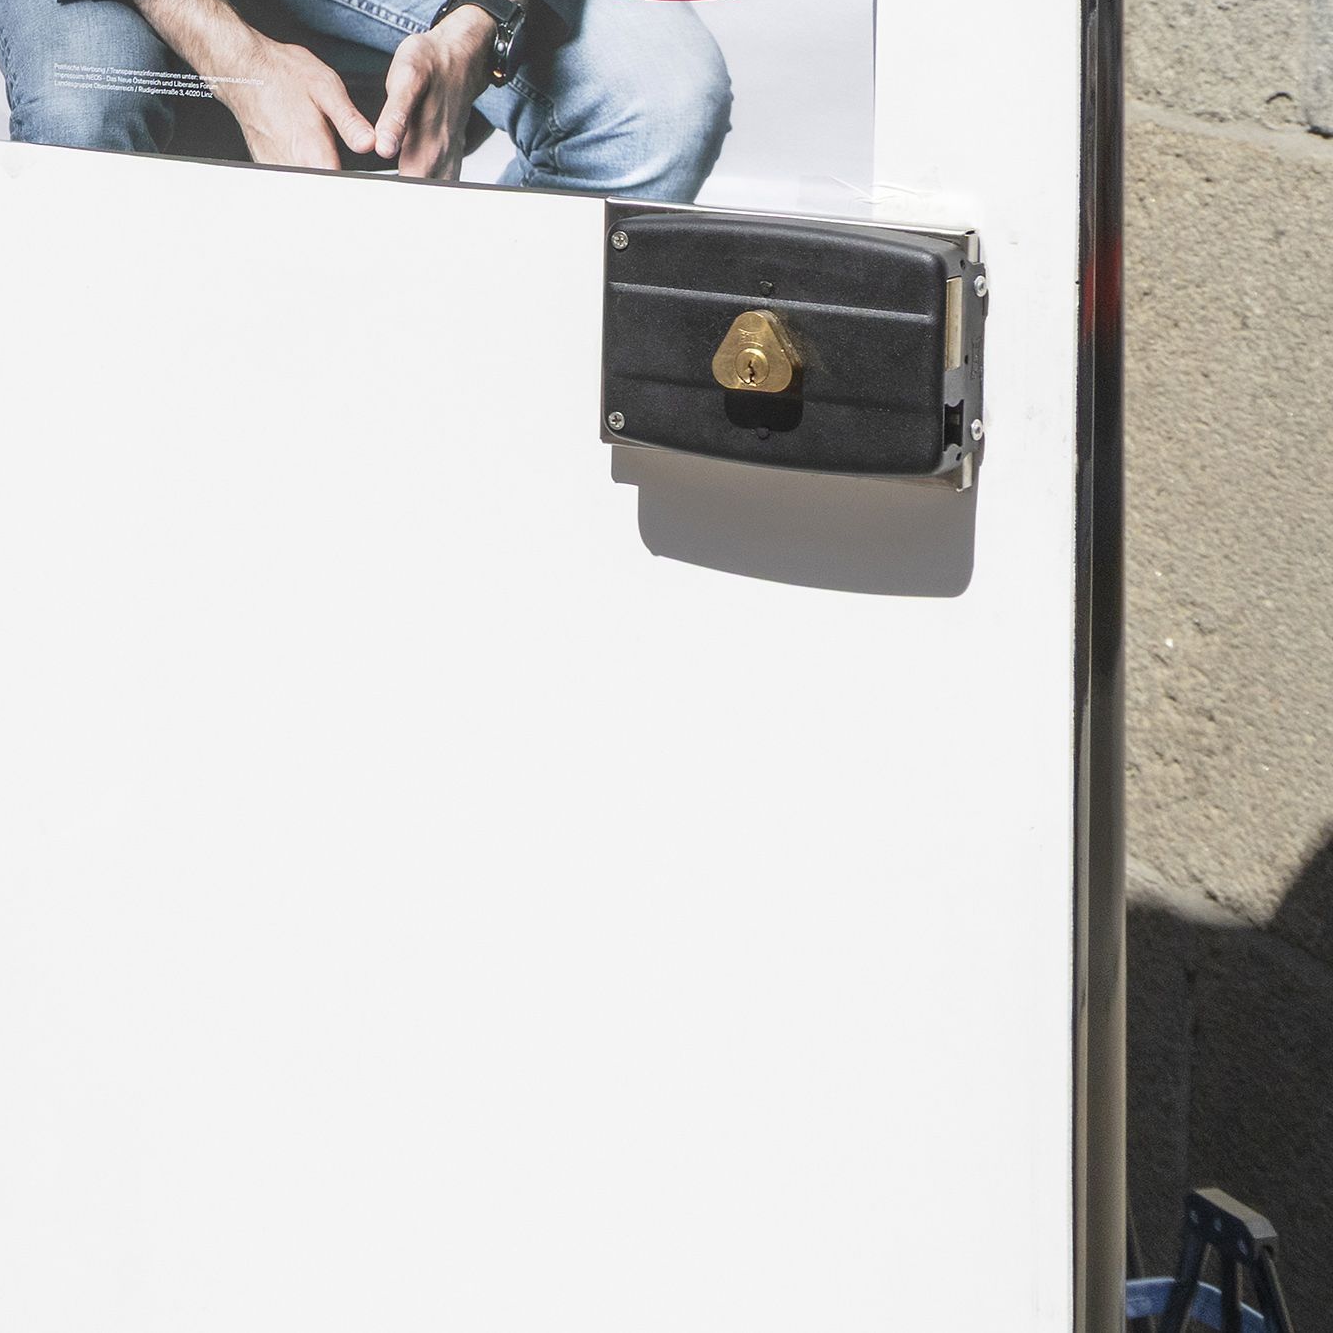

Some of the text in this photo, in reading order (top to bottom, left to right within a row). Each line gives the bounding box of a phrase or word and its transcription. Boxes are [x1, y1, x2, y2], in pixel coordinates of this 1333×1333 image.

[133, 76, 161, 85] Österreich
[174, 81, 199, 89] Liberales
[185, 89, 200, 97] 4020
